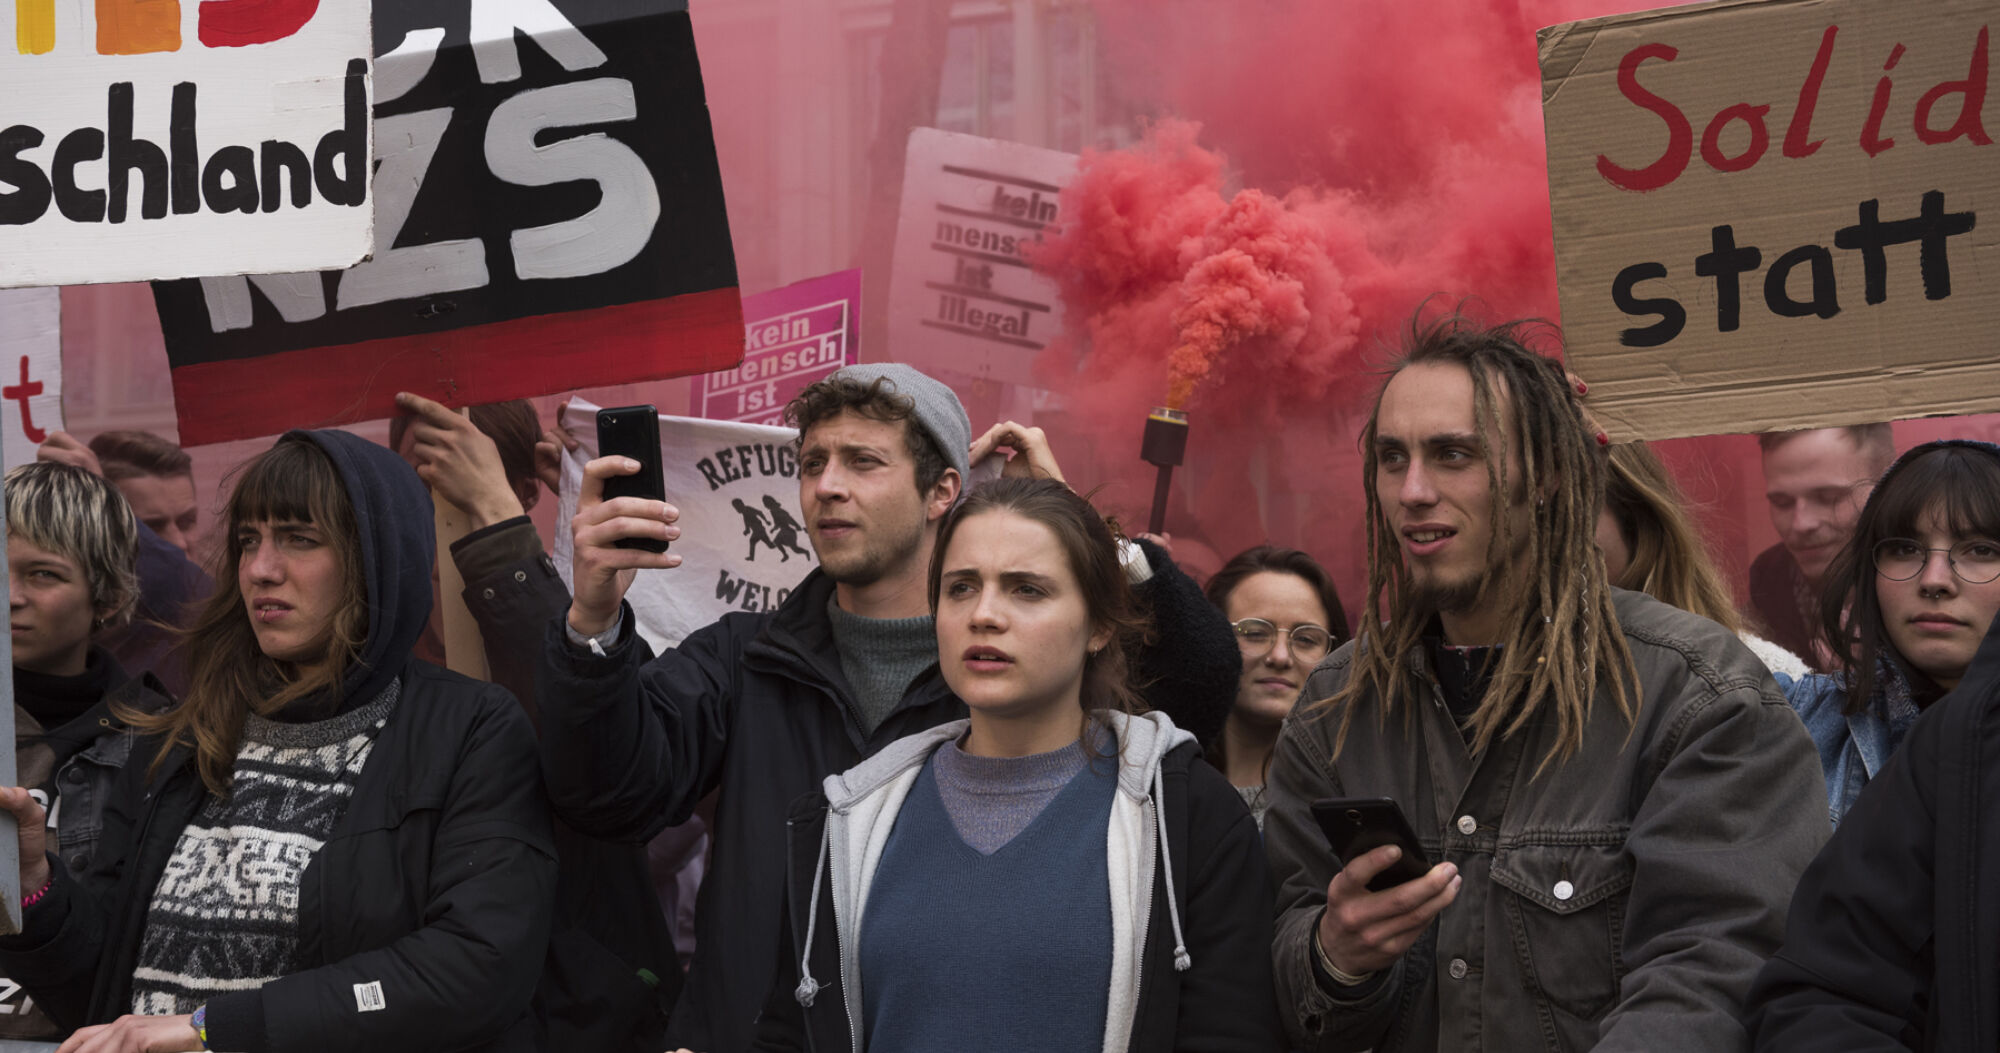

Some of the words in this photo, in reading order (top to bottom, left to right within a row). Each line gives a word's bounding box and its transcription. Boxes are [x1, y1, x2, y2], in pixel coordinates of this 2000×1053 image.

[1596, 25, 1994, 193] Solid
[992, 185, 1058, 222] kein
[954, 257, 993, 290] ist
[1612, 190, 1976, 347] statt
[745, 314, 810, 350] kein
[938, 294, 1030, 337] illegal
[712, 335, 837, 389] mensch
[3, 355, 47, 443] t
[737, 380, 777, 414] ist
[696, 443, 801, 491] REFUG
